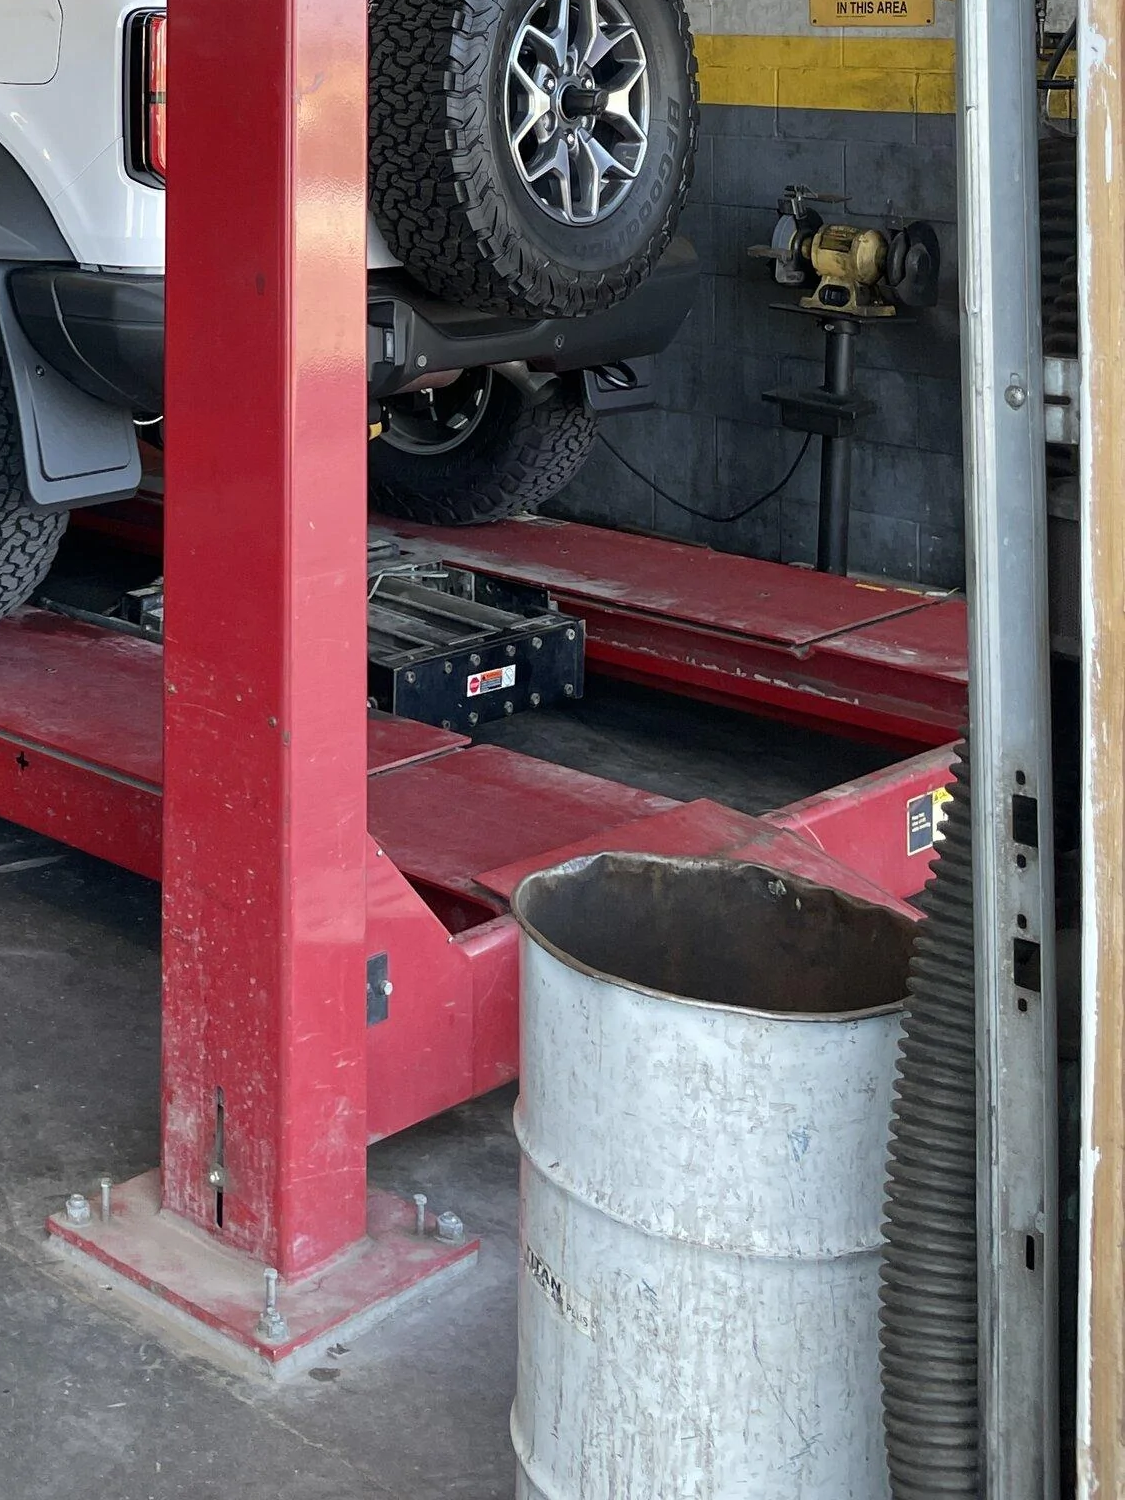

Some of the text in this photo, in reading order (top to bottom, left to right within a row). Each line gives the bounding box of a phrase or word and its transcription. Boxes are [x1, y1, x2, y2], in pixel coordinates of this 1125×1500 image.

[837, 1, 907, 14] IN THIS AREA
